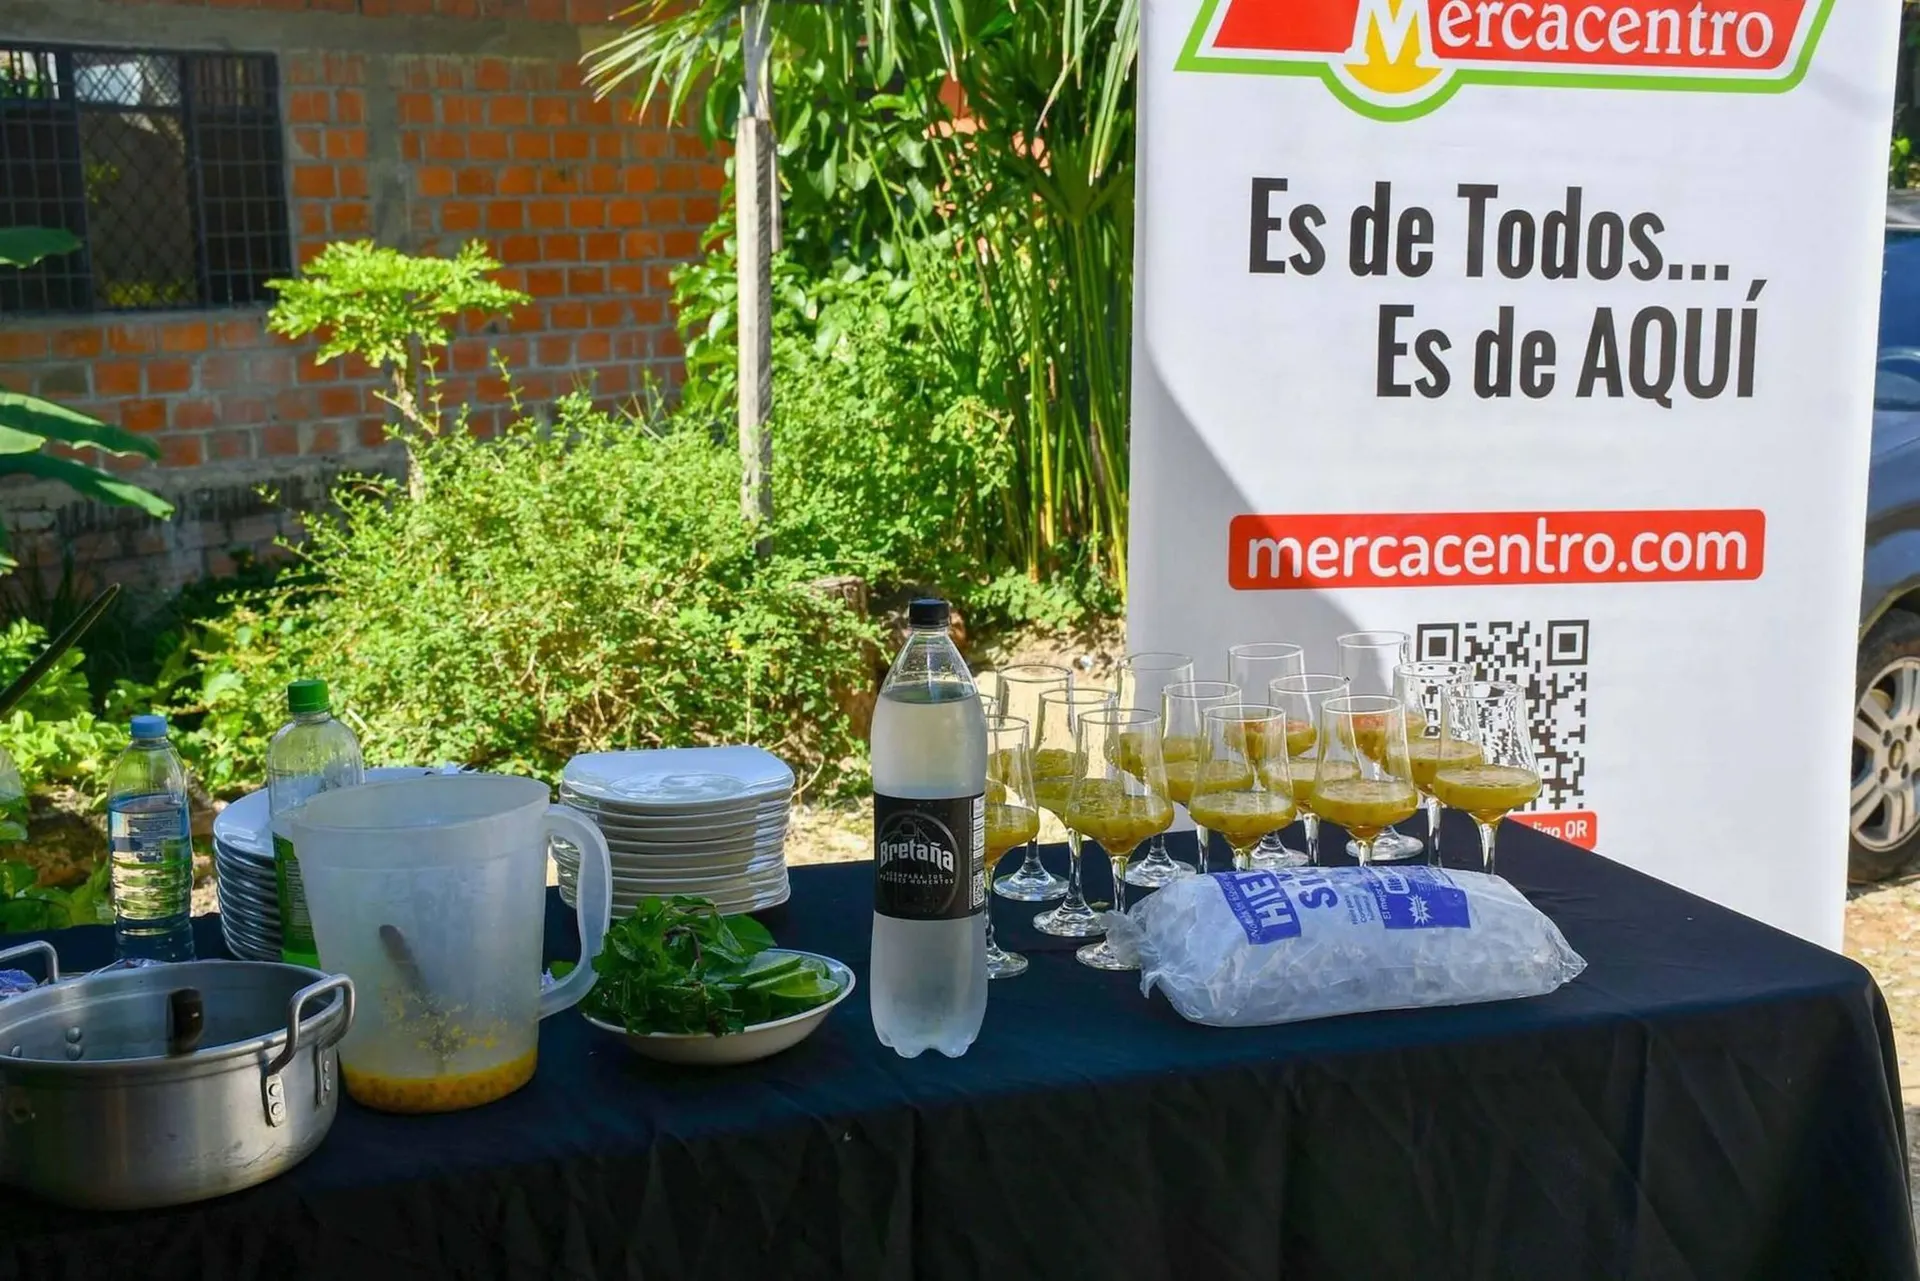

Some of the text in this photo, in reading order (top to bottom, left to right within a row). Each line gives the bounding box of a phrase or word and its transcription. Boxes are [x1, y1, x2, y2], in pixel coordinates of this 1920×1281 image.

[1343, 0, 1775, 67] Mercacentro
[1249, 177, 1729, 281] Es de Todos...
[1376, 280, 1767, 409] Es de AQUÍ
[1247, 517, 1747, 578] mercacentro.com
[880, 838, 954, 873] Bretaña
[1565, 820, 1587, 839] QR
